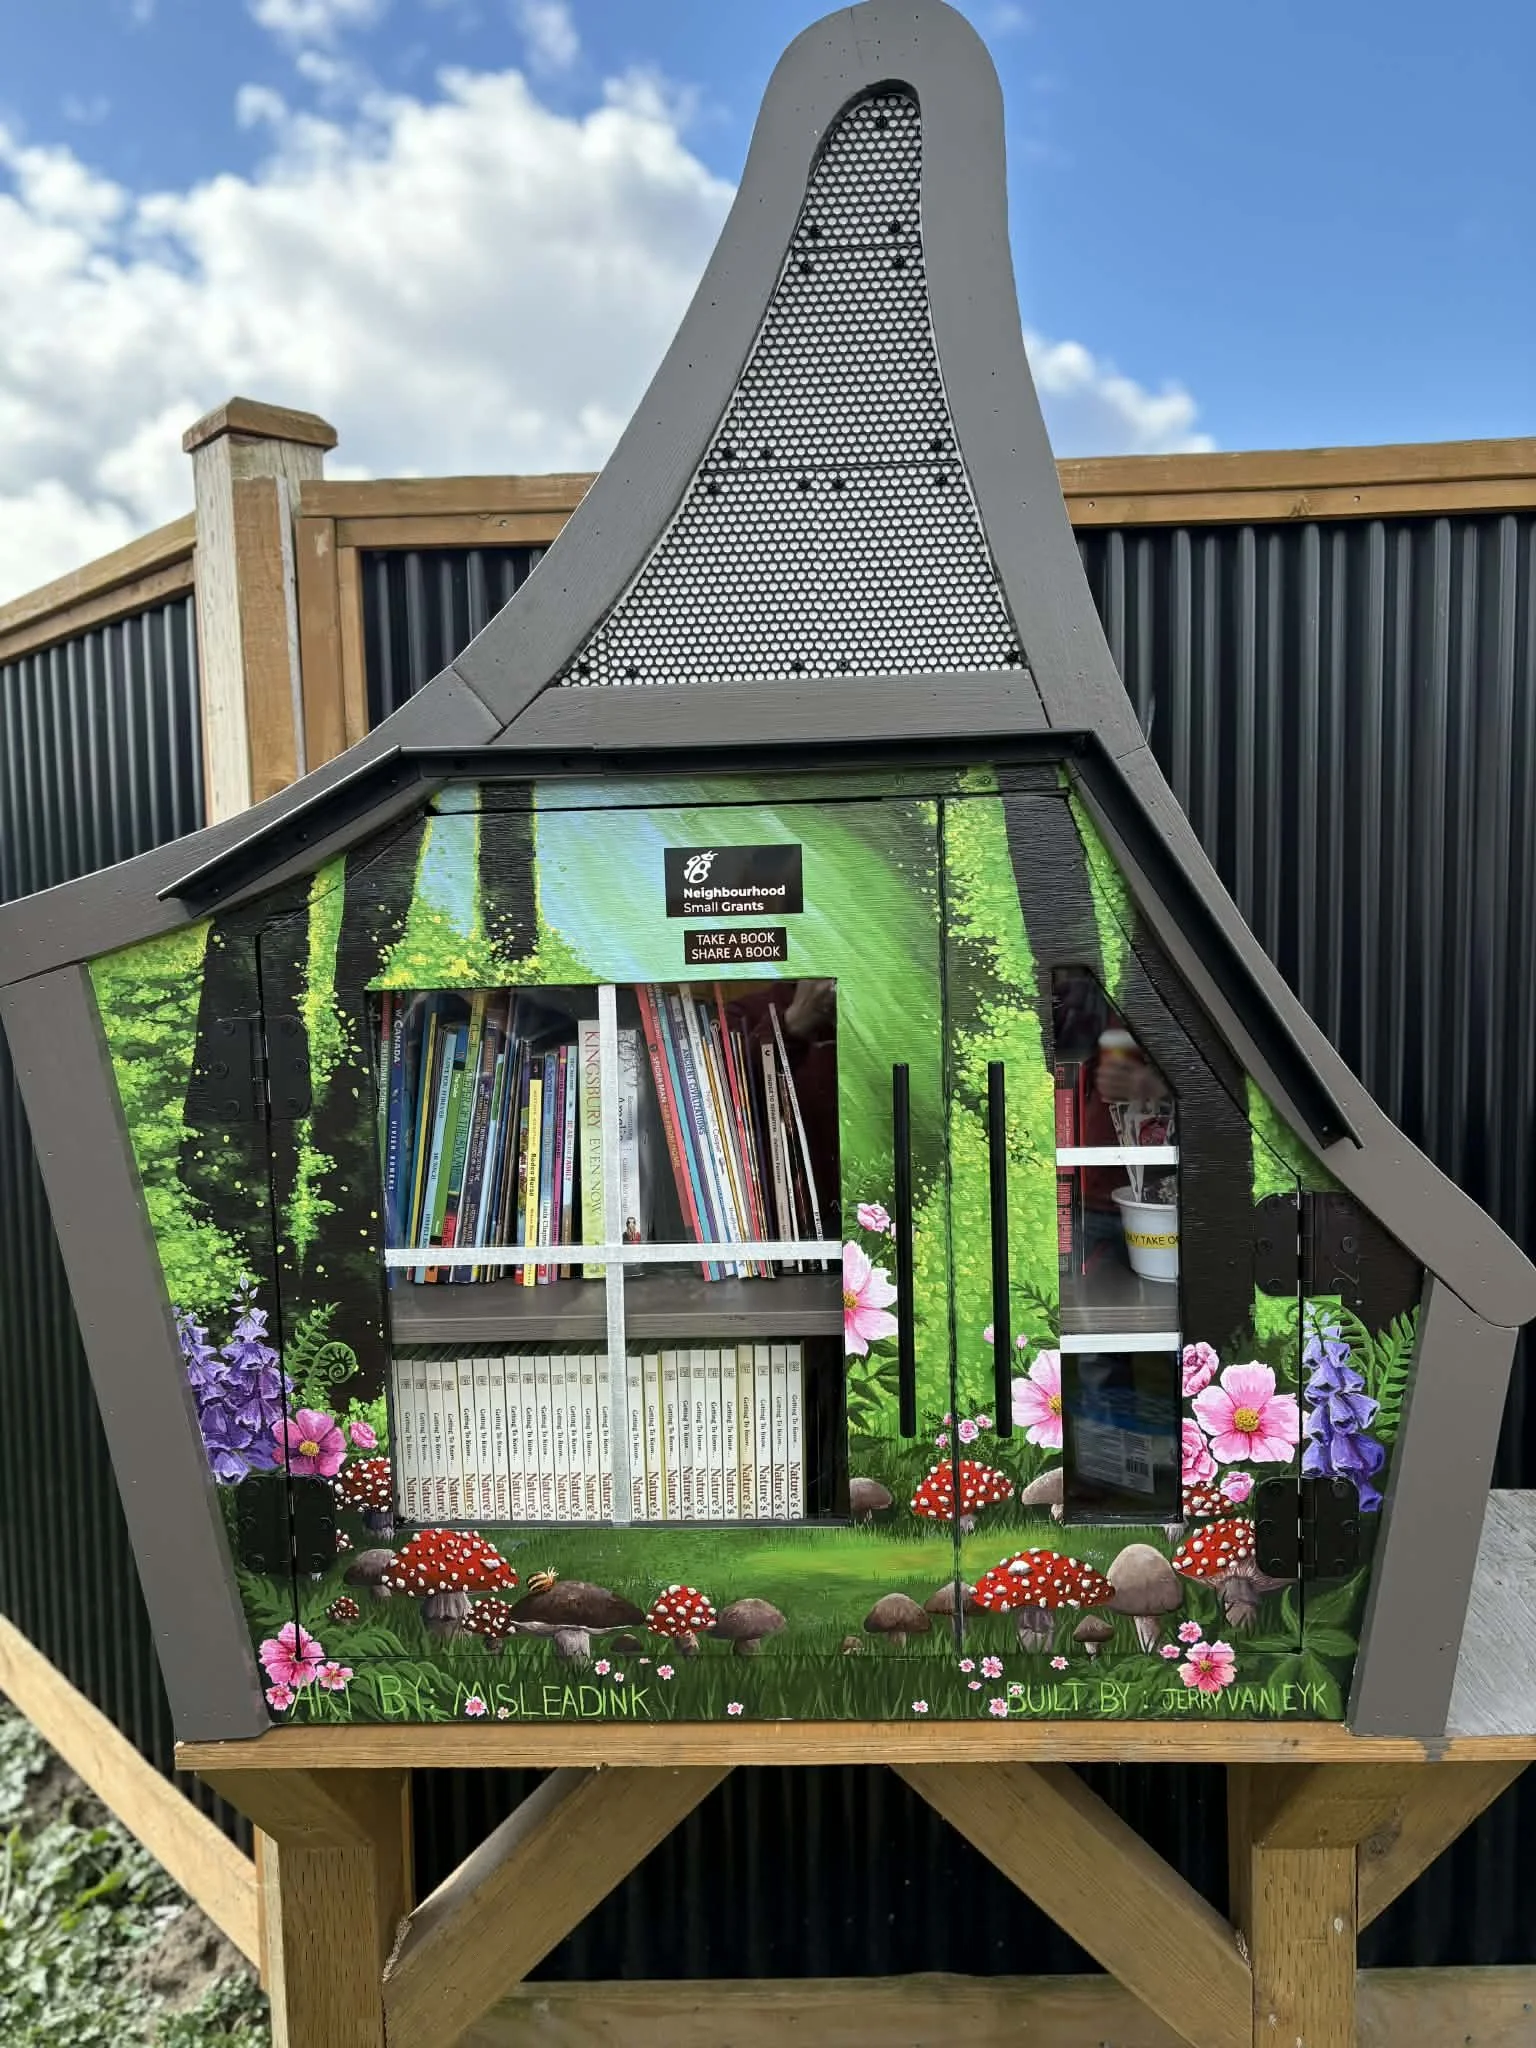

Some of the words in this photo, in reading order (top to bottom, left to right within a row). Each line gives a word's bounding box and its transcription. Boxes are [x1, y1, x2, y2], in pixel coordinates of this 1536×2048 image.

[683, 885, 786, 900] Neighbourhood
[683, 902, 718, 913] Small
[721, 901, 765, 912] Grants
[691, 948, 730, 960] SHARE
[733, 948, 743, 959] A
[746, 945, 780, 958] BOOK
[696, 933, 725, 946] TAKE
[728, 933, 738, 945] A
[740, 931, 775, 944] BOOK
[380, 1040, 389, 1086] SENSATIONAL
[394, 1020, 403, 1063] CANADA
[462, 1068, 474, 1102] KEEPER
[585, 1031, 601, 1129] KINGSBURY
[457, 1122, 470, 1140] THE
[589, 1138, 601, 1175] EVEN
[591, 1181, 601, 1215] NOW
[1140, 1235, 1165, 1246] TAKE
[465, 1473, 477, 1518] Nature's
[481, 1473, 492, 1519] Nature's
[496, 1474, 507, 1520] Nature's
[512, 1472, 522, 1517] Nature's
[527, 1473, 538, 1518] Nature's
[542, 1473, 553, 1518] Nature's
[557, 1474, 569, 1519] Nature's
[571, 1472, 582, 1517] Nature's
[586, 1474, 597, 1520] Nature's
[602, 1472, 613, 1518] Nature's
[633, 1476, 643, 1520] Nature's
[649, 1472, 660, 1516] Nature's
[667, 1469, 678, 1514] Nature's
[683, 1466, 694, 1510] Nature's
[696, 1468, 707, 1514] Nature's
[710, 1468, 720, 1514] Nature's
[726, 1468, 736, 1514] Nature's
[743, 1464, 753, 1510] Nature's
[760, 1465, 770, 1511] Nature's
[775, 1463, 785, 1509] Nature's
[791, 1461, 801, 1508] Nature's
[291, 1676, 360, 1717] ART
[453, 1682, 651, 1716] MISLEADINK
[1006, 1681, 1088, 1713] BUILT
[1160, 1688, 1223, 1712] JERRY
[1226, 1687, 1276, 1713] VAN
[1282, 1681, 1328, 1712] EYK
